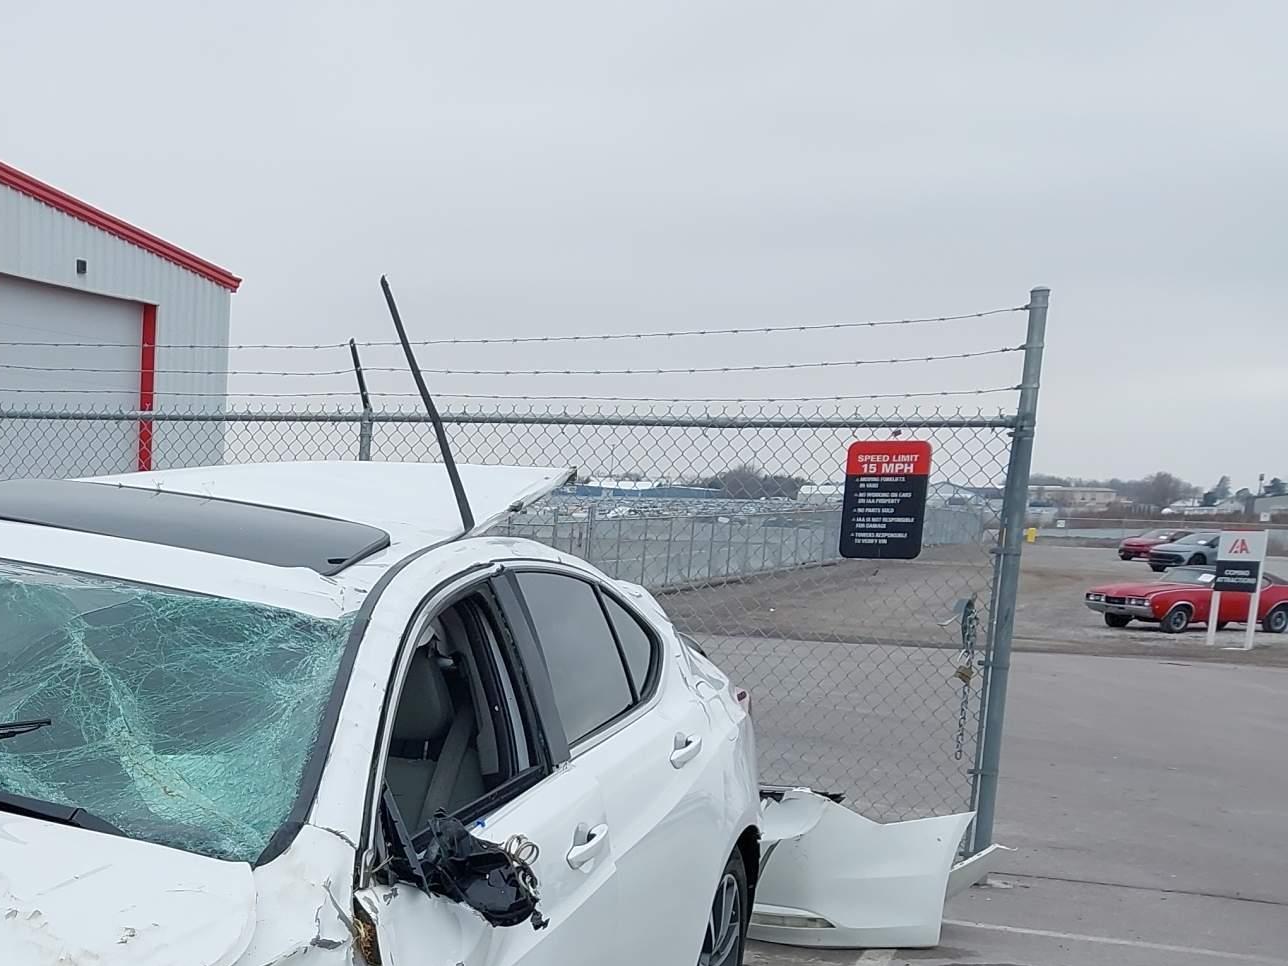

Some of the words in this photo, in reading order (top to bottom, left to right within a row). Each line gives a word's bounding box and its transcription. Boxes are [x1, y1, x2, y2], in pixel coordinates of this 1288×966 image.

[858, 454, 889, 462] SPEED
[892, 454, 920, 462] LIMIT
[862, 463, 876, 473] 15
[881, 463, 914, 473] MPH
